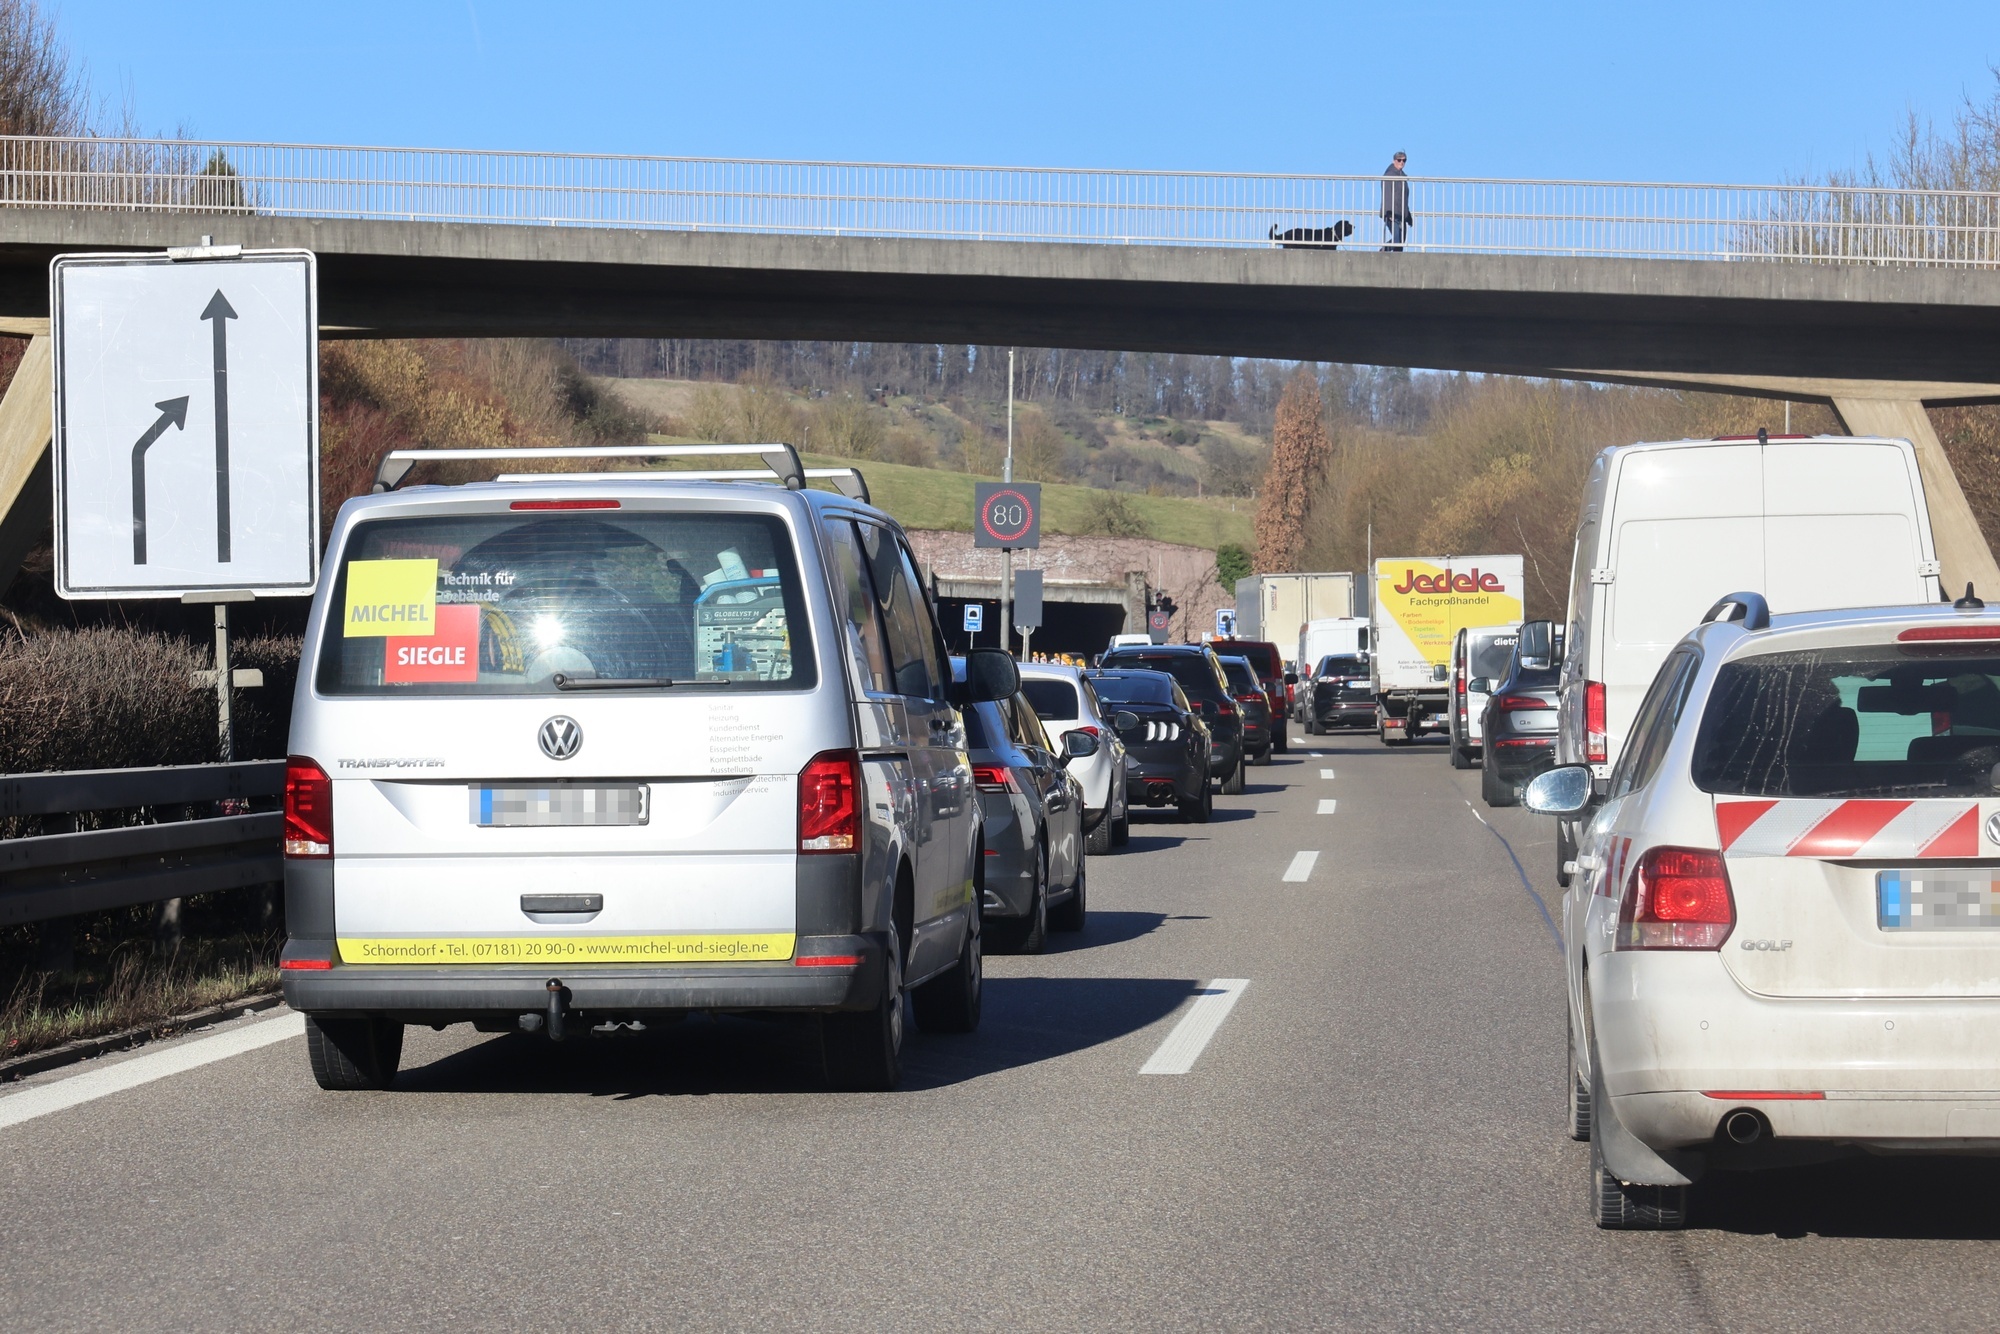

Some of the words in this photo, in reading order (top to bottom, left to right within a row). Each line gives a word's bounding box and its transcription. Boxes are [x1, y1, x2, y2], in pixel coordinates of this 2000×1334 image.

[993, 504, 1022, 526] 80
[443, 573, 491, 586] Technik
[495, 572, 514, 585] für
[1393, 567, 1505, 595] Jedele
[1410, 596, 1490, 607] Fachgroßhandel
[351, 604, 428, 622] MICHEL
[1494, 637, 1519, 646] dietri
[397, 646, 466, 666] SIEGLE
[708, 714, 739, 722] Heizung
[709, 724, 760, 732] Kundendienst
[710, 734, 749, 742] Alternative
[751, 733, 783, 742] Energien
[710, 745, 750, 753] Eisspeicher
[338, 758, 445, 768] TRANSPORTER
[711, 766, 753, 774] Ausstellung
[713, 775, 788, 788] Schwimmbdtechnik
[713, 786, 769, 797] Industrieervice
[363, 944, 436, 956] Schorndorf
[446, 944, 469, 956] Tel.
[472, 943, 522, 957] (07181)
[525, 943, 542, 955] 20
[545, 942, 575, 955] 90-0
[1741, 939, 1792, 951] GOLF
